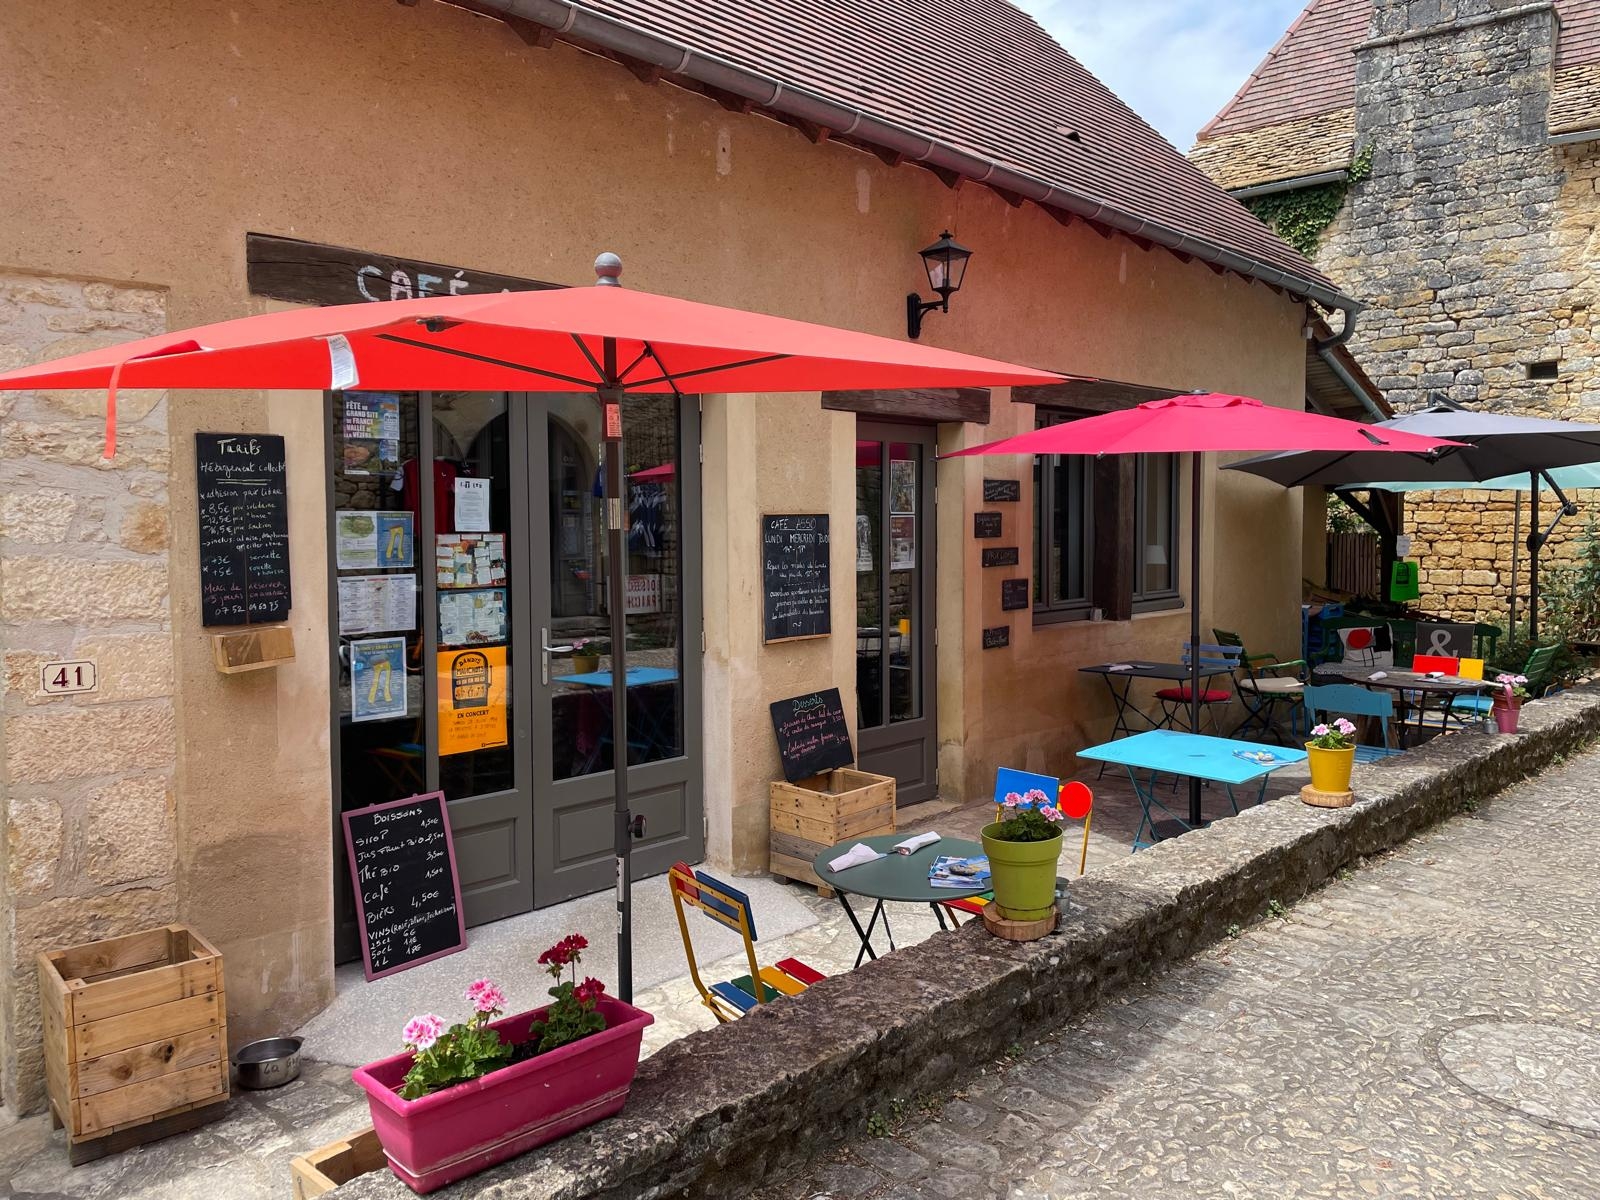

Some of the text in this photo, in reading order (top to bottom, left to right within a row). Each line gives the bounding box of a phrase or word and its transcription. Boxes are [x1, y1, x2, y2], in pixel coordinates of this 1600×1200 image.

[356, 270, 469, 302] CAFÉ
[346, 401, 361, 410] FÊTE
[352, 417, 374, 425] FRANCE
[52, 666, 84, 687] 41
[465, 709, 490, 718] CONCERT
[373, 807, 423, 825] BOISSONS
[358, 864, 378, 883] Thé
[363, 881, 392, 904] Café
